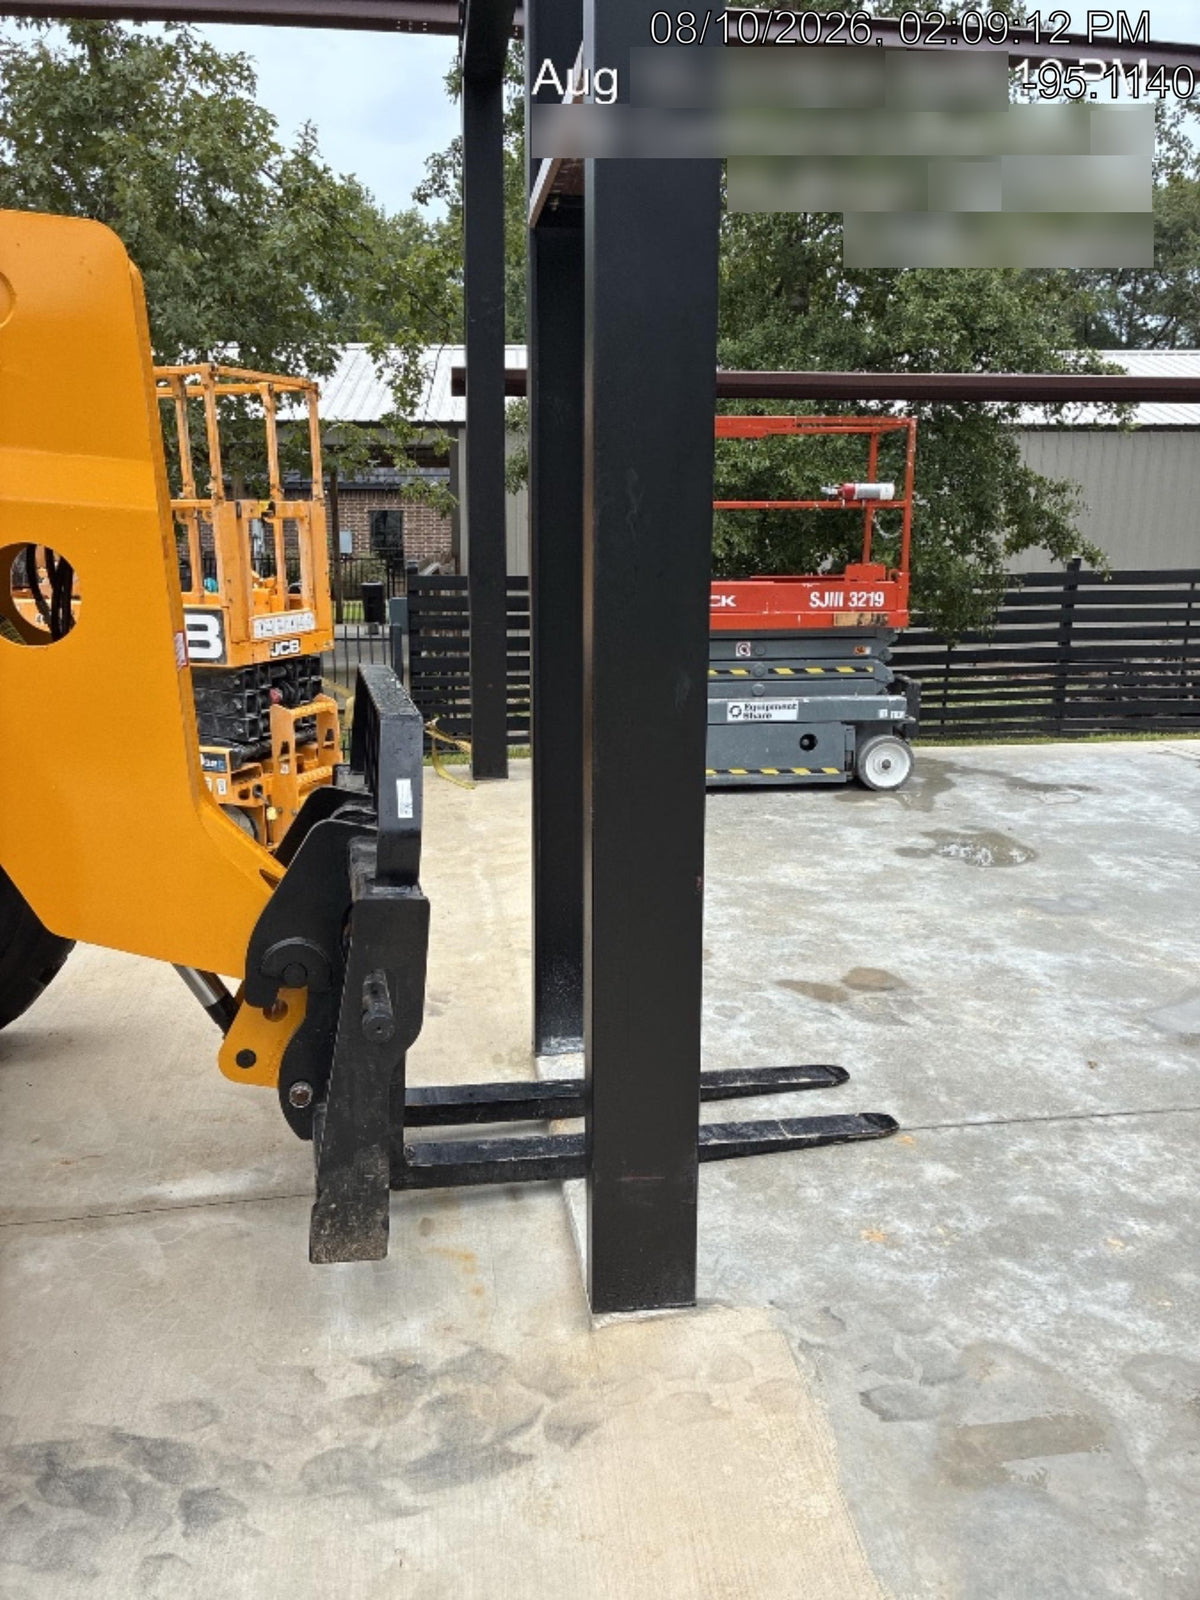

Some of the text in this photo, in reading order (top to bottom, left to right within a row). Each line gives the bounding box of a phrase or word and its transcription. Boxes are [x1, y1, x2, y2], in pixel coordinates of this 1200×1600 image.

[848, 591, 885, 607] 3219
[271, 639, 300, 657] JCB
[744, 703, 798, 712] Equipment
